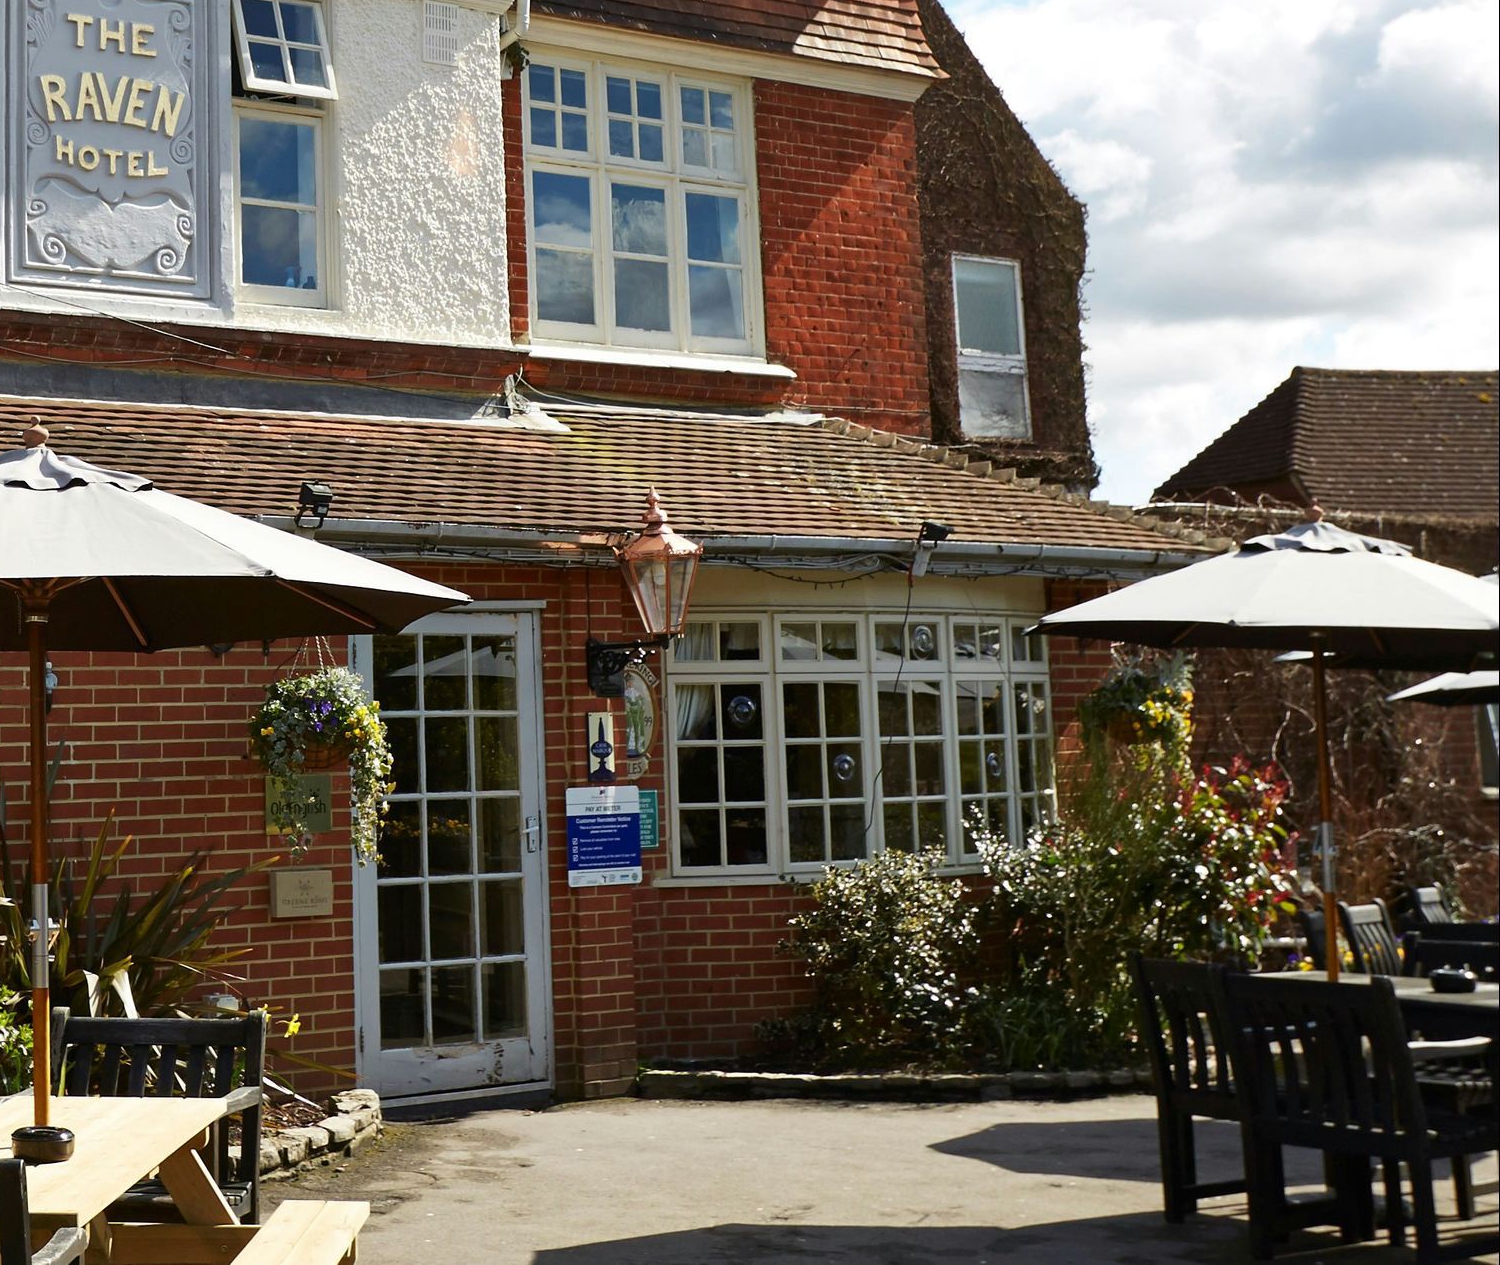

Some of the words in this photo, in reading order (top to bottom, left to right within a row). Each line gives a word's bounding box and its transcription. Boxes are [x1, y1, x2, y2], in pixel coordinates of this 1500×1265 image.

[66, 12, 158, 58] THE
[38, 71, 186, 138] RAVEN
[55, 134, 169, 177] HOTEL
[643, 716, 653, 727] 99
[627, 762, 643, 775] LES
